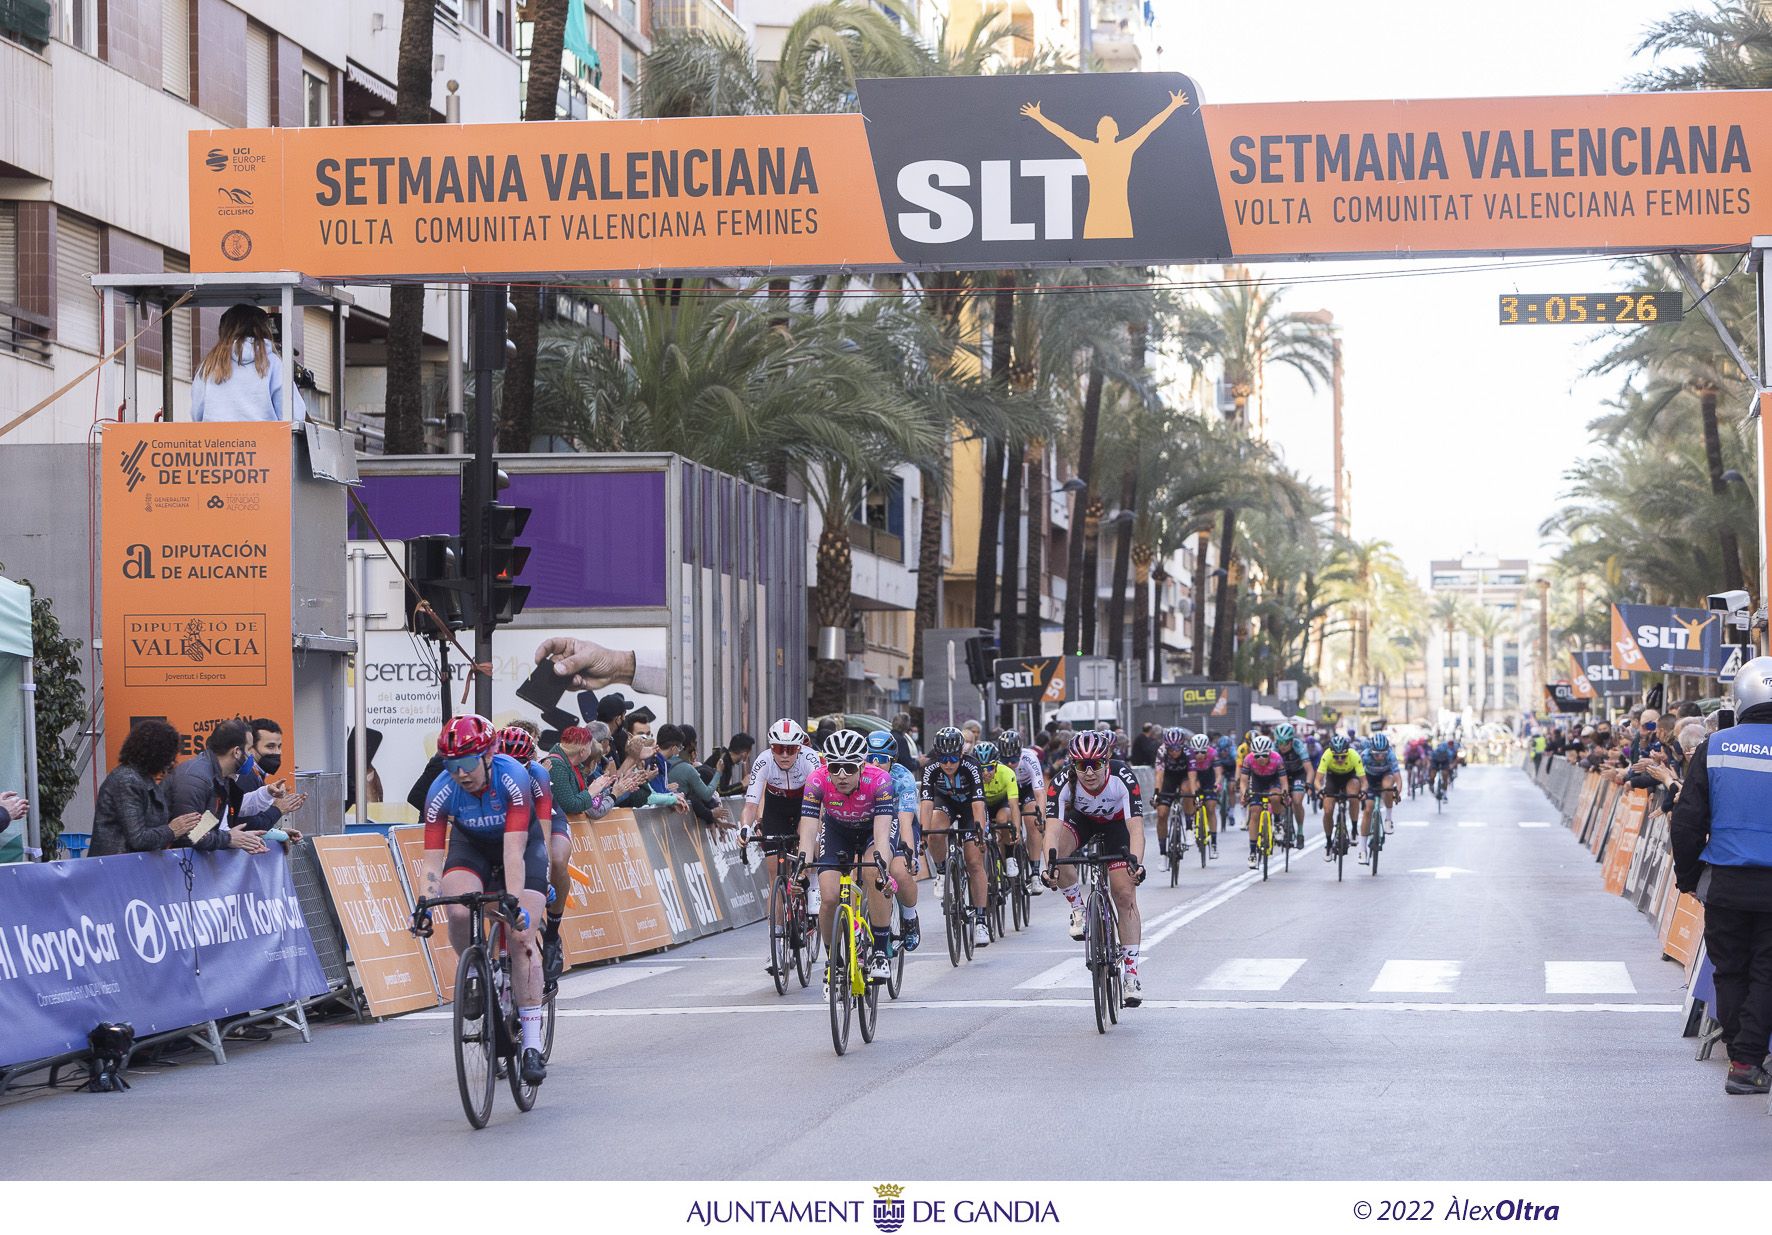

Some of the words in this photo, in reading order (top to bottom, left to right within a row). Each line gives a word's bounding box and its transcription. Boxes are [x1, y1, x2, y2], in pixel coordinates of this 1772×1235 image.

[232, 156, 267, 164] EUROPE
[1229, 131, 1449, 185] SETMANA
[1462, 124, 1752, 179] VALENCIANA
[233, 164, 256, 172] TOUR
[315, 154, 528, 207] SETMANA
[540, 146, 819, 201] VALENCIANA
[218, 208, 255, 216] CICLISMO
[1235, 197, 1312, 226] VOLTA
[1333, 193, 1474, 223] COMUNITAT
[1484, 190, 1636, 220] VALENCIANA
[1646, 187, 1751, 216] FEMINES
[320, 218, 394, 246] VOLTA
[415, 214, 551, 244] COMUNITAT
[561, 210, 707, 241] VALENCIANA
[716, 207, 818, 236] FEMINES
[151, 439, 202, 449] Comunitat
[204, 439, 257, 448] Valenciana
[151, 451, 257, 468] COMUNITAT
[159, 469, 182, 485] DE
[187, 468, 270, 485] L'ESPORT
[162, 539, 267, 558] DIPUTACIÓN
[161, 566, 182, 579] DE
[187, 565, 268, 579] ALICANTE
[235, 621, 258, 632] DE
[1616, 636, 1641, 665] 25
[165, 672, 195, 682] Joventut
[200, 672, 227, 682] Esports
[395, 690, 440, 701] automóvi
[365, 706, 397, 714] uertas
[1118, 767, 1135, 785] Liv
[501, 773, 524, 806] CERATIZIT
[426, 783, 453, 824] CERATIZIT
[377, 863, 393, 883] DE
[160, 893, 249, 951] HYUNDAI
